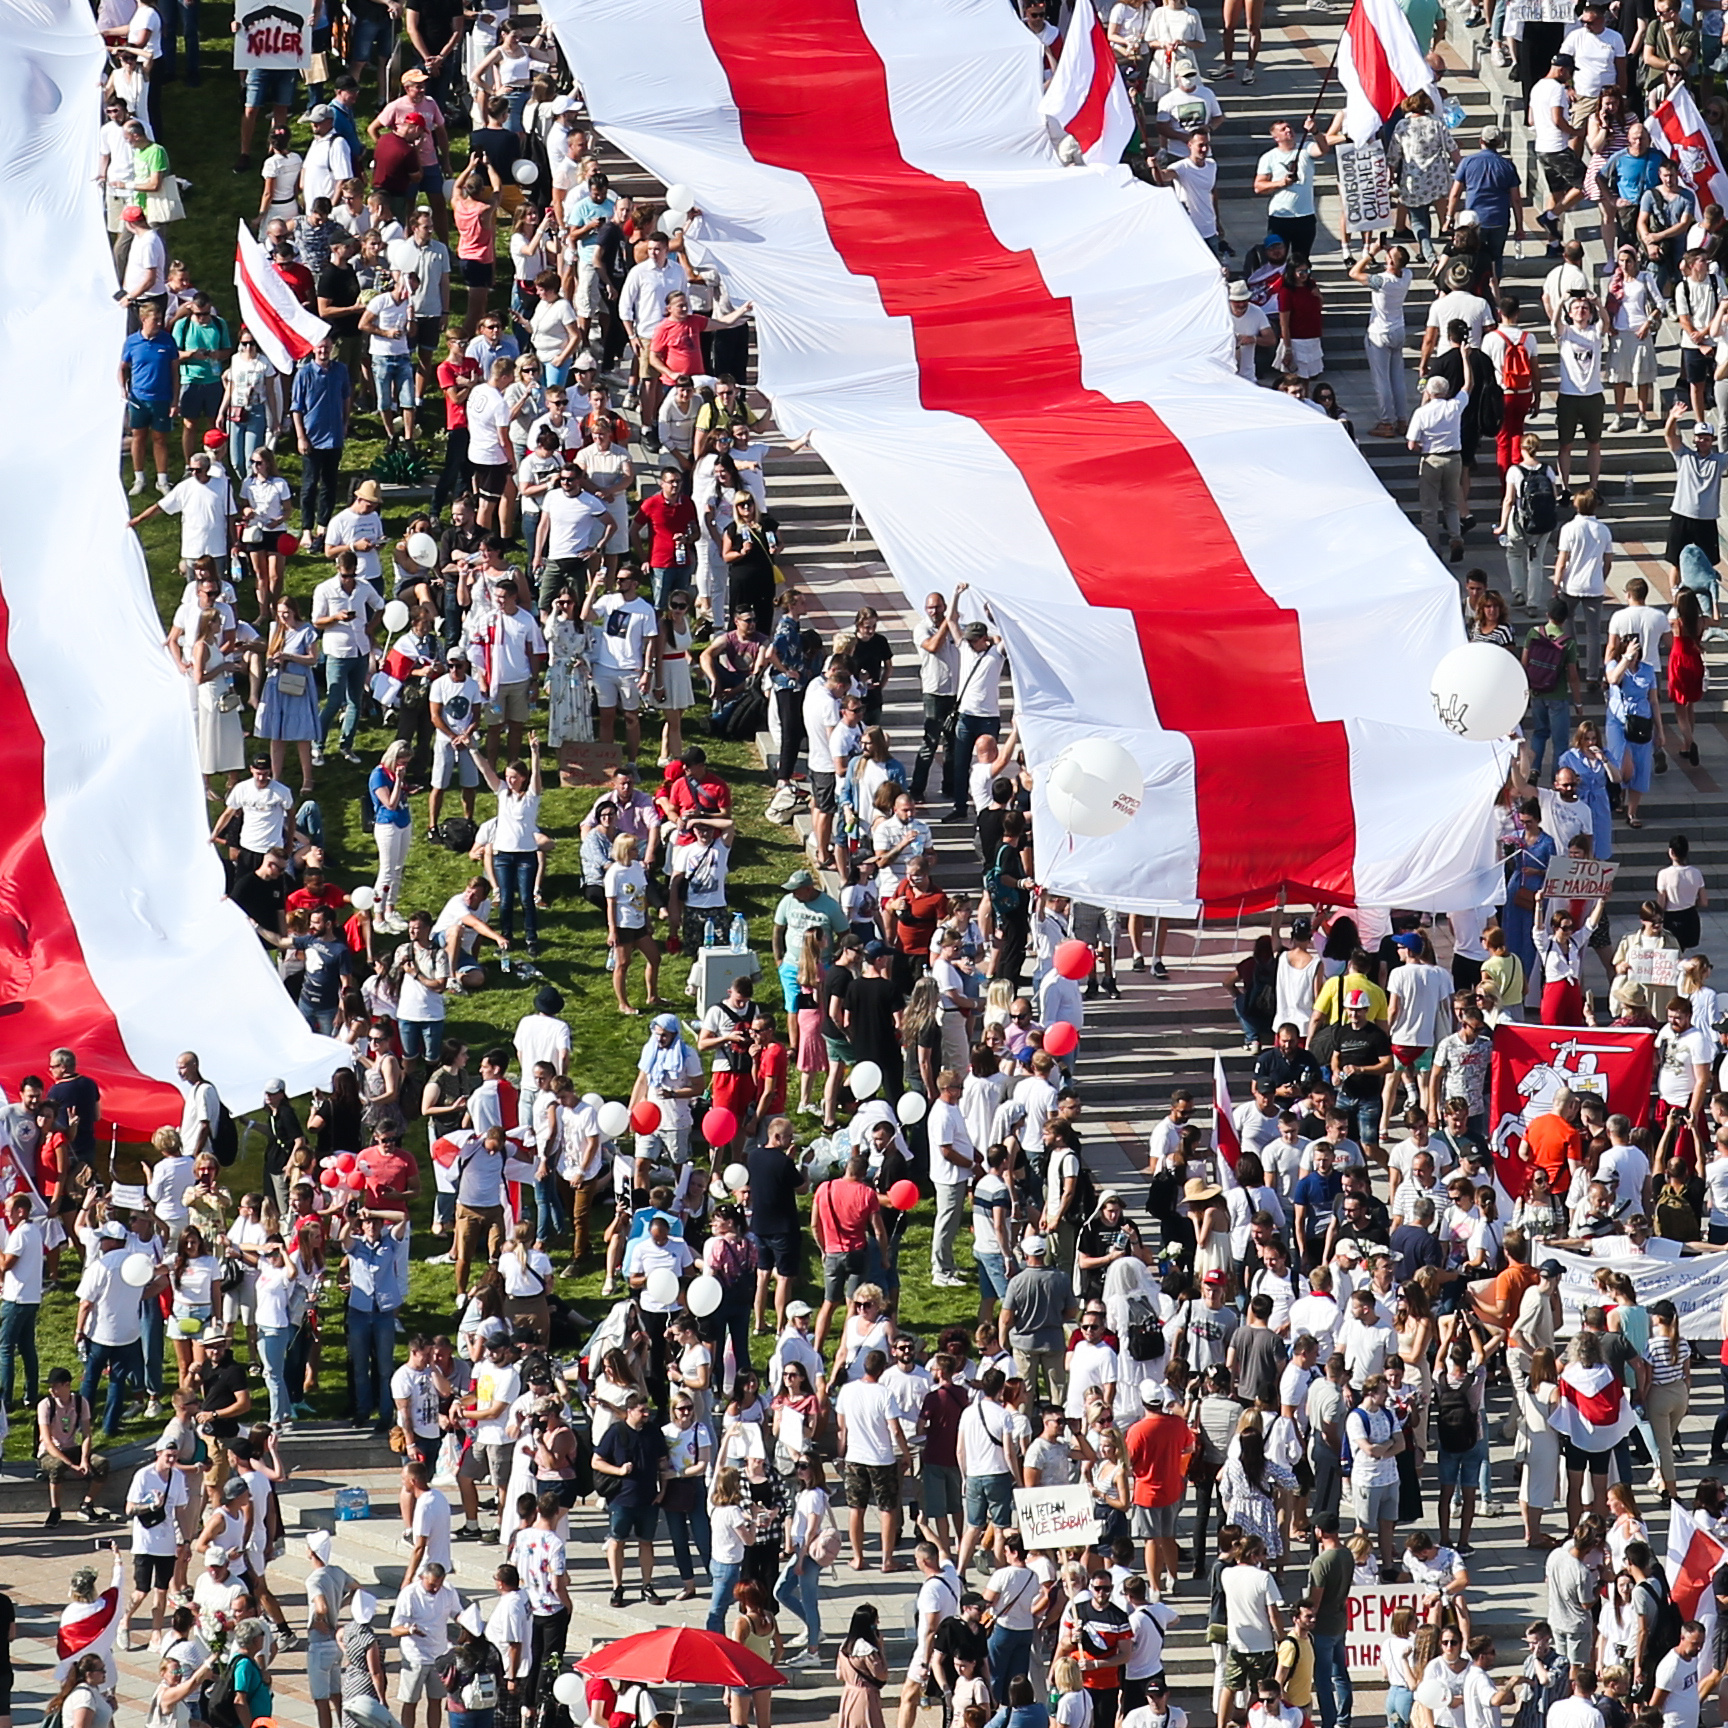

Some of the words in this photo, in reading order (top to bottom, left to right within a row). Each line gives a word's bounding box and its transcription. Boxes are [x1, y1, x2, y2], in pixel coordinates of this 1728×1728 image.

[1340, 150, 1362, 223] СВОБОДА
[1357, 149, 1378, 222] СИЛЬНЕЕ
[1569, 862, 1599, 875] ЭТО
[1545, 879, 1560, 894] НЕ
[1630, 950, 1667, 960] ВЫБОРЫ
[1053, 1508, 1093, 1531] БЫВАЙ!
